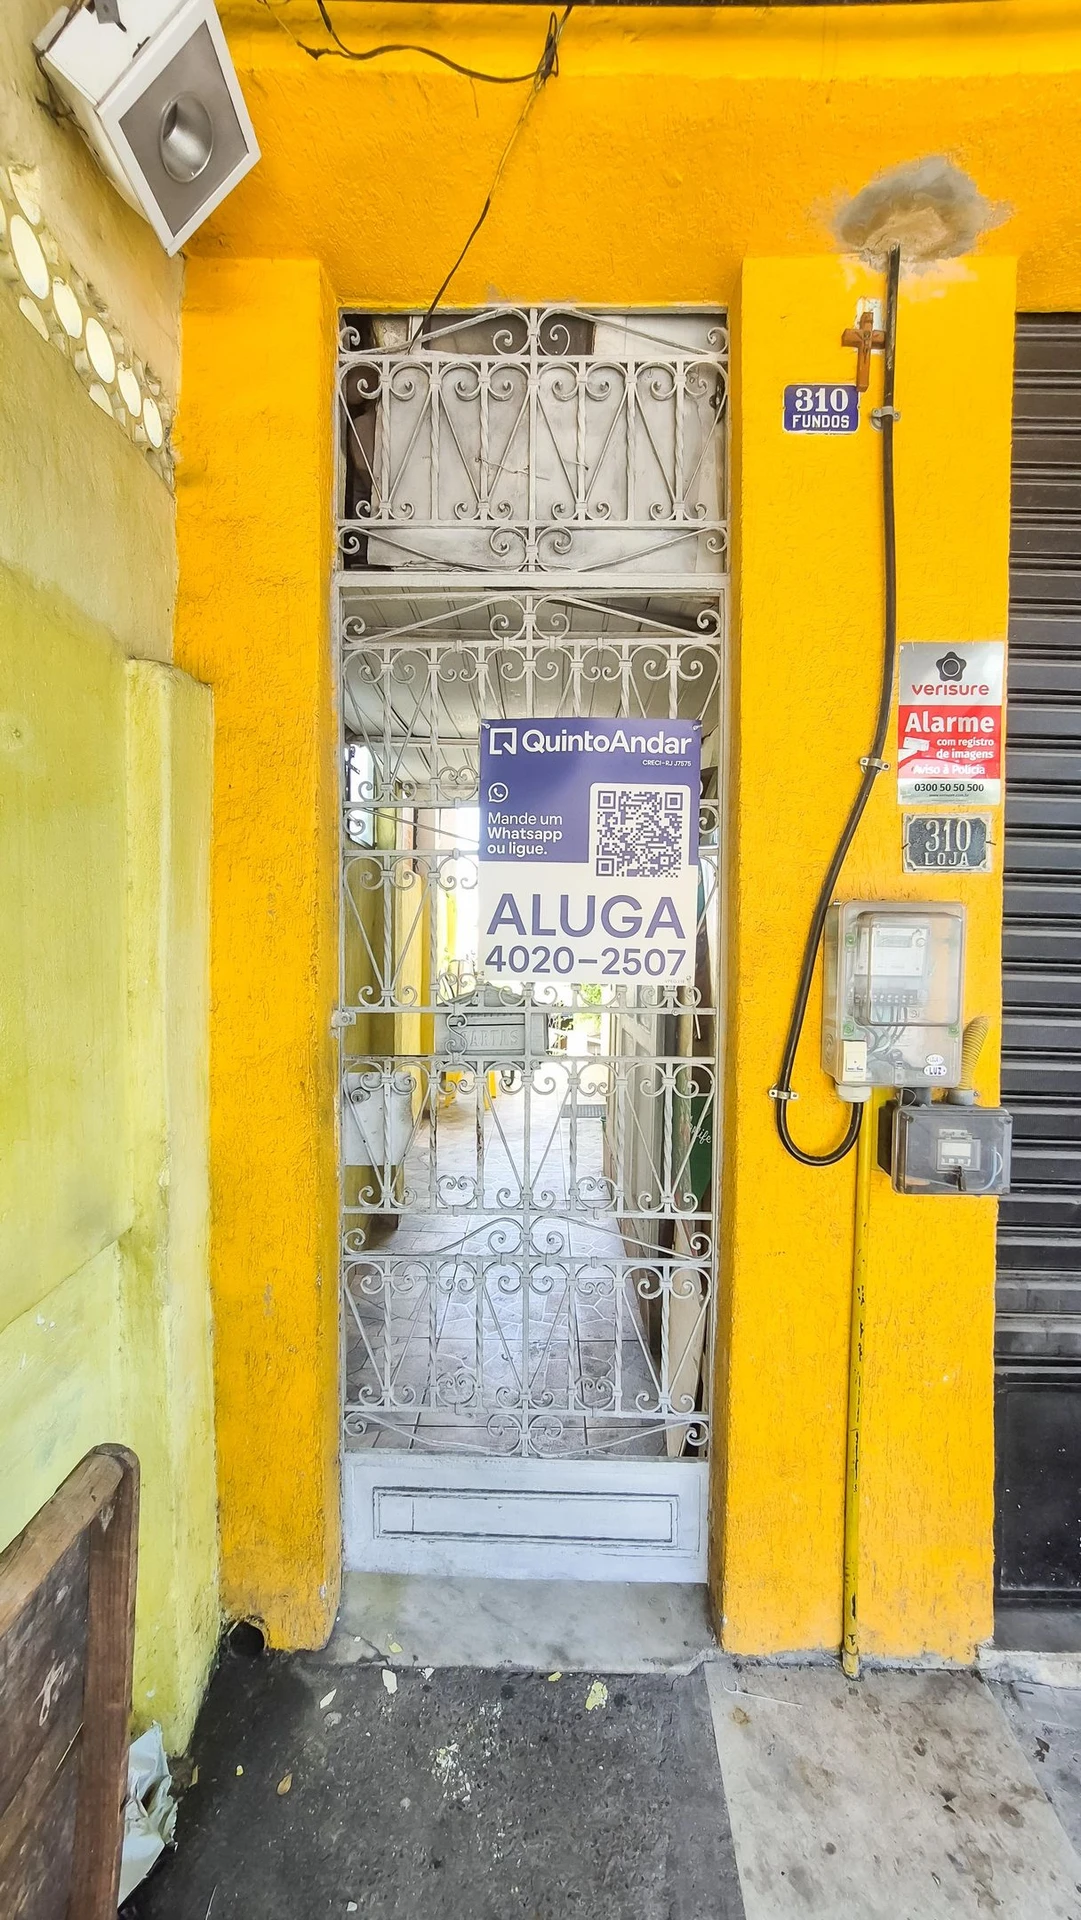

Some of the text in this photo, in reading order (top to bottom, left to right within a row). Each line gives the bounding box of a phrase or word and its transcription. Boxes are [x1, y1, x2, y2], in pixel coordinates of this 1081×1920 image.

[795, 387, 849, 412] 310
[792, 414, 850, 429] FUNDOS
[911, 683, 990, 696] verisure
[904, 710, 995, 734] Alarme
[521, 729, 692, 755] QuintoAndar
[936, 737, 995, 748] com registro
[936, 748, 994, 761] de imagens
[913, 764, 986, 775] Aviso à Polícia
[914, 783, 984, 792] 0300 50 50 500
[487, 811, 563, 826] Mande um
[487, 826, 563, 843] Whatsapp
[925, 819, 972, 852] 310
[487, 842, 548, 857] ou ligue.
[924, 851, 970, 867] LOJA
[486, 893, 686, 940] ALUGA
[485, 945, 687, 976] 4020-2507
[929, 1066, 942, 1075] LUZ
